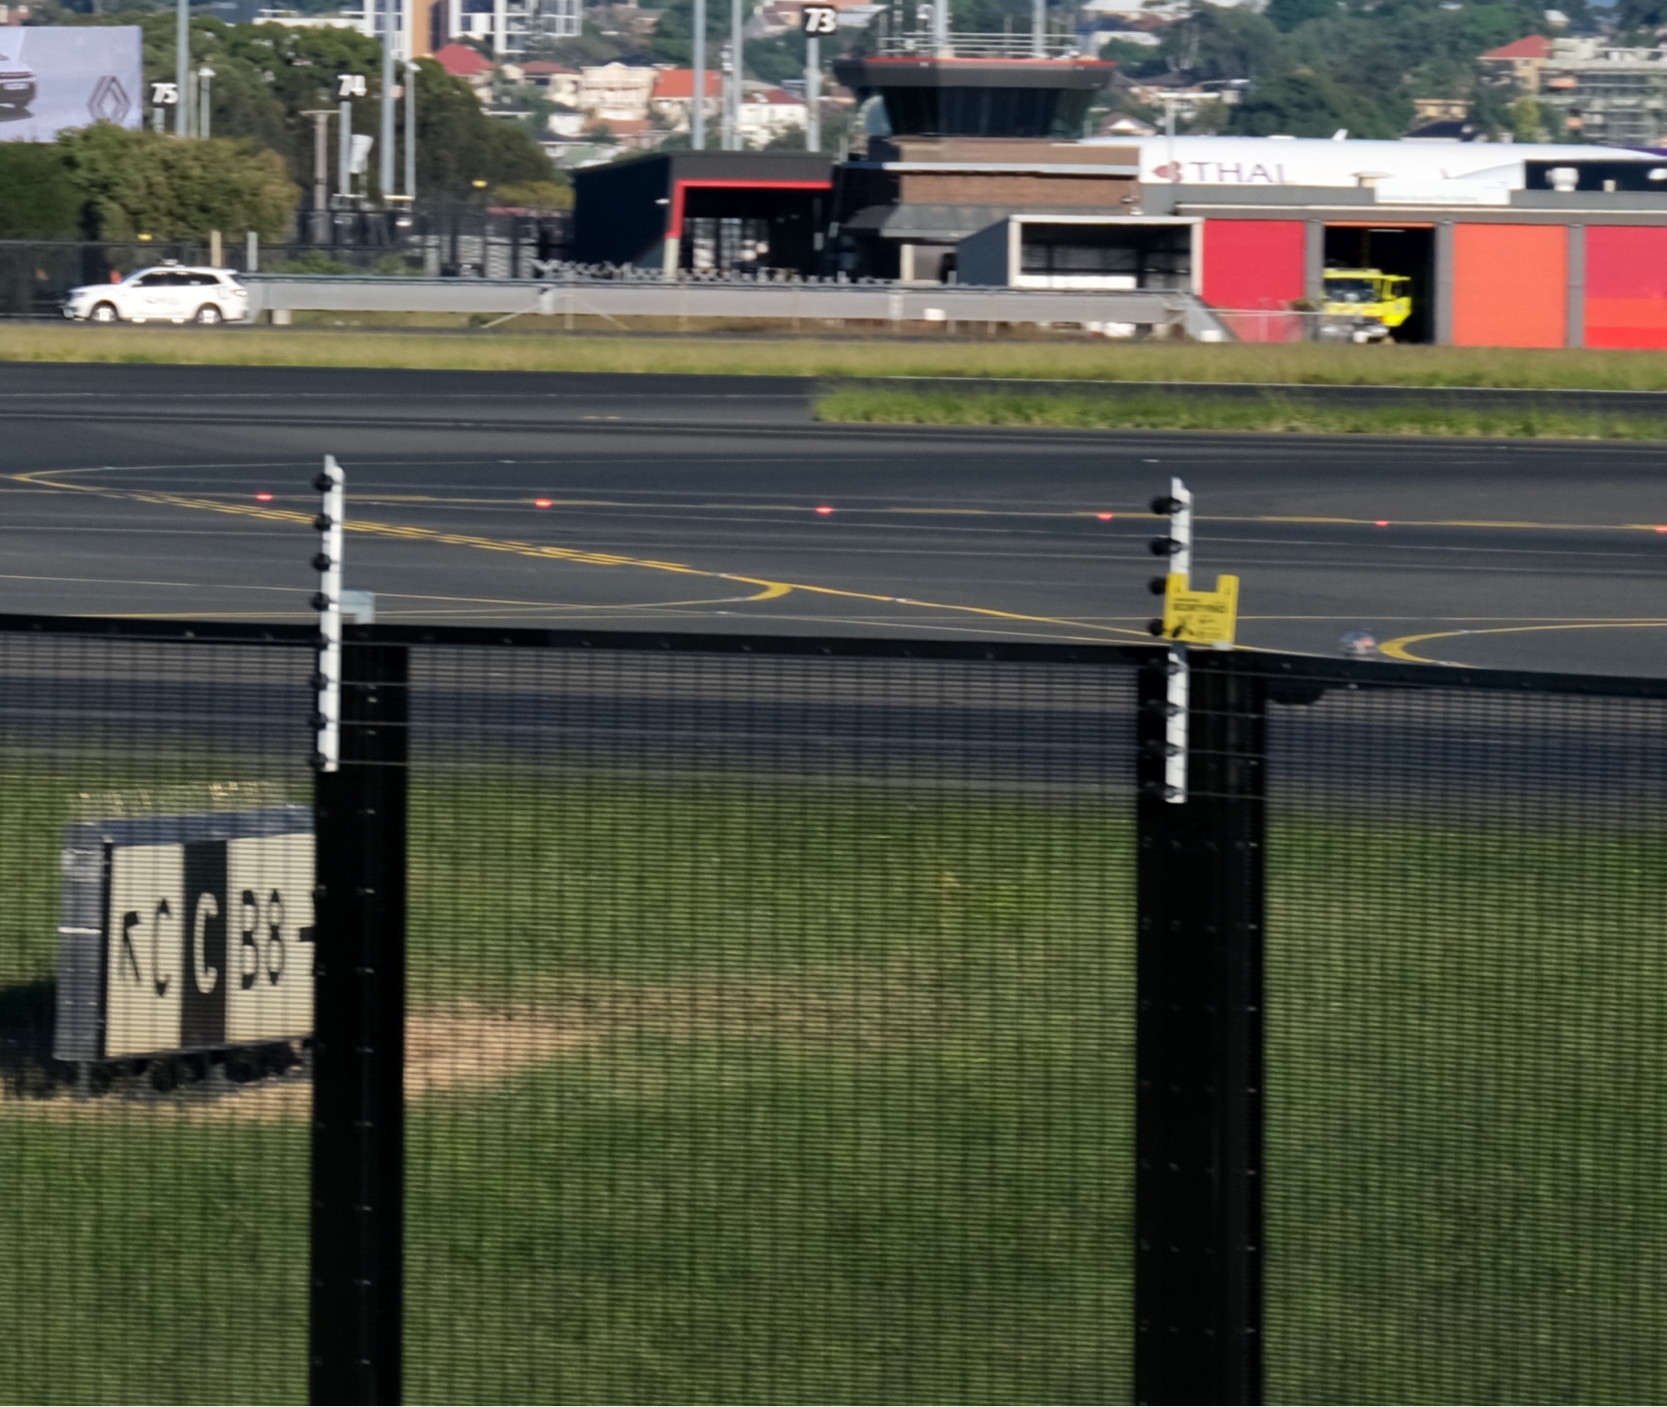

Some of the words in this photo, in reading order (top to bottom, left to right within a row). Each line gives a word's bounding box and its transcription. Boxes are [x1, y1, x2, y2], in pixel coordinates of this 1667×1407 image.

[804, 7, 836, 33] 73
[151, 82, 179, 104] 75
[194, 893, 219, 994] C
